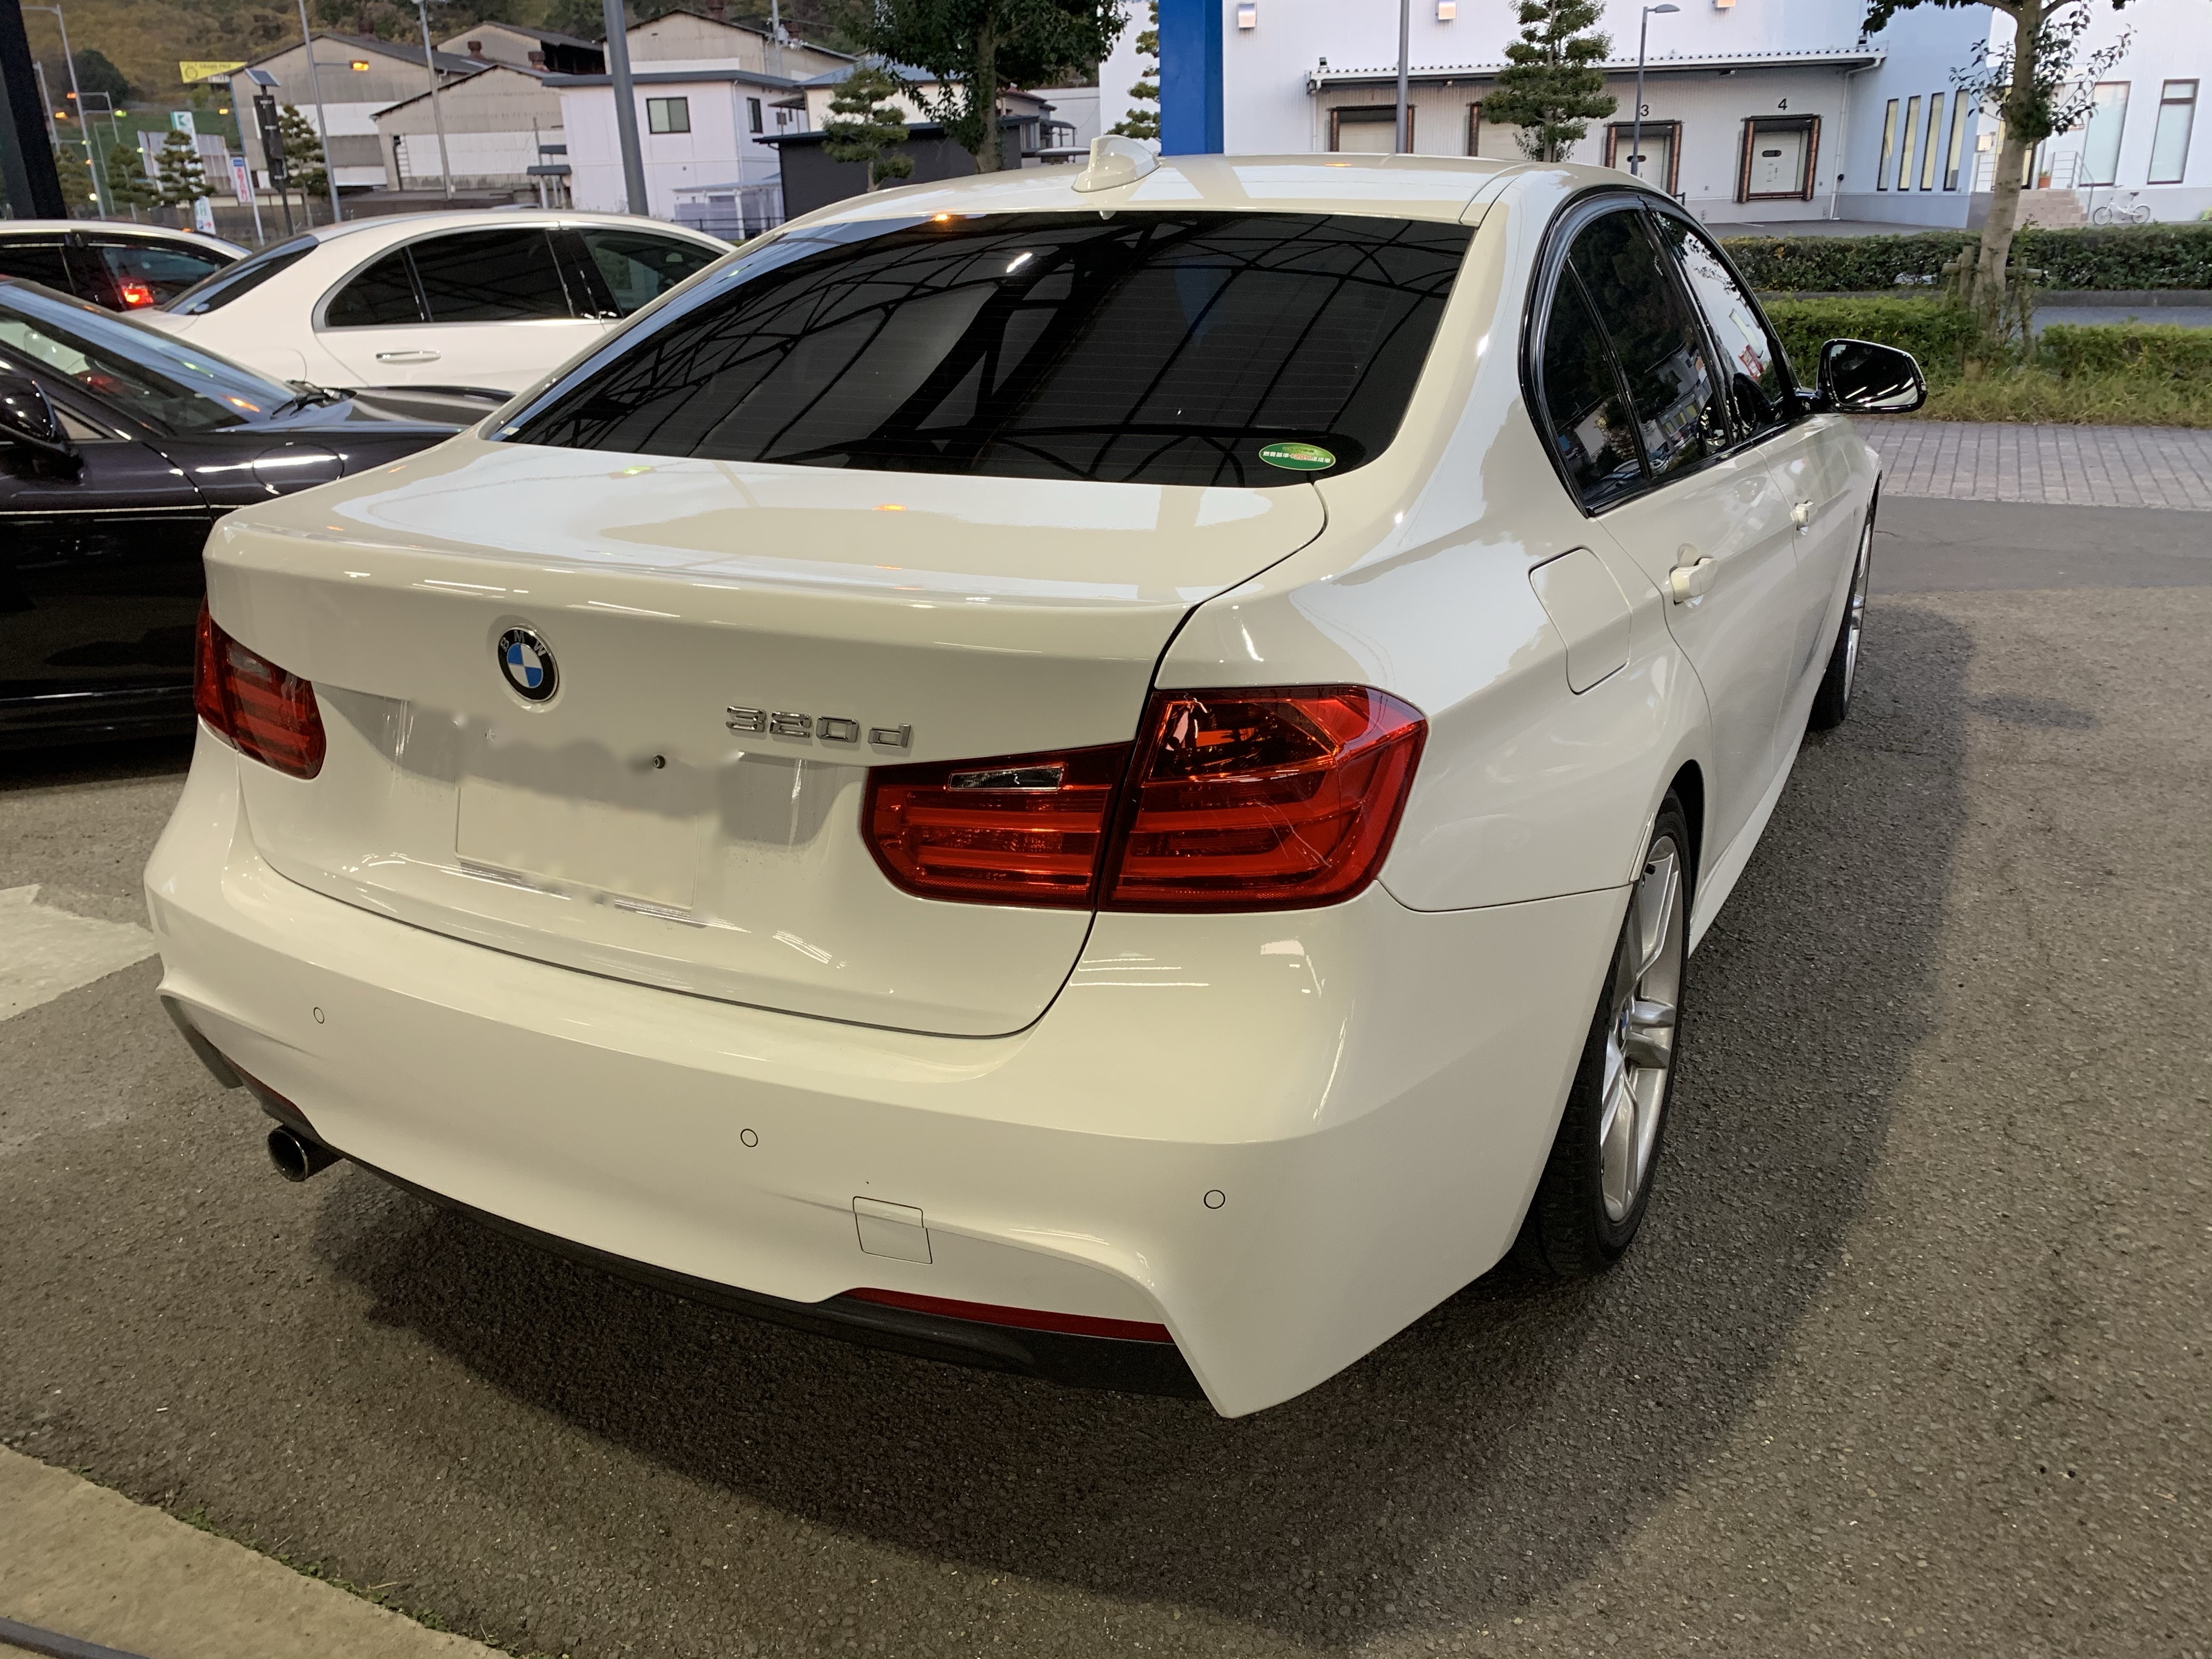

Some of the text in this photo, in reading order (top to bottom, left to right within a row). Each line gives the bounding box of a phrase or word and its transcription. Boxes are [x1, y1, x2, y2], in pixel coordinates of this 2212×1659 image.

[1640, 104, 1650, 117] 3
[1778, 98, 1788, 111] 4
[499, 629, 548, 657] BMW
